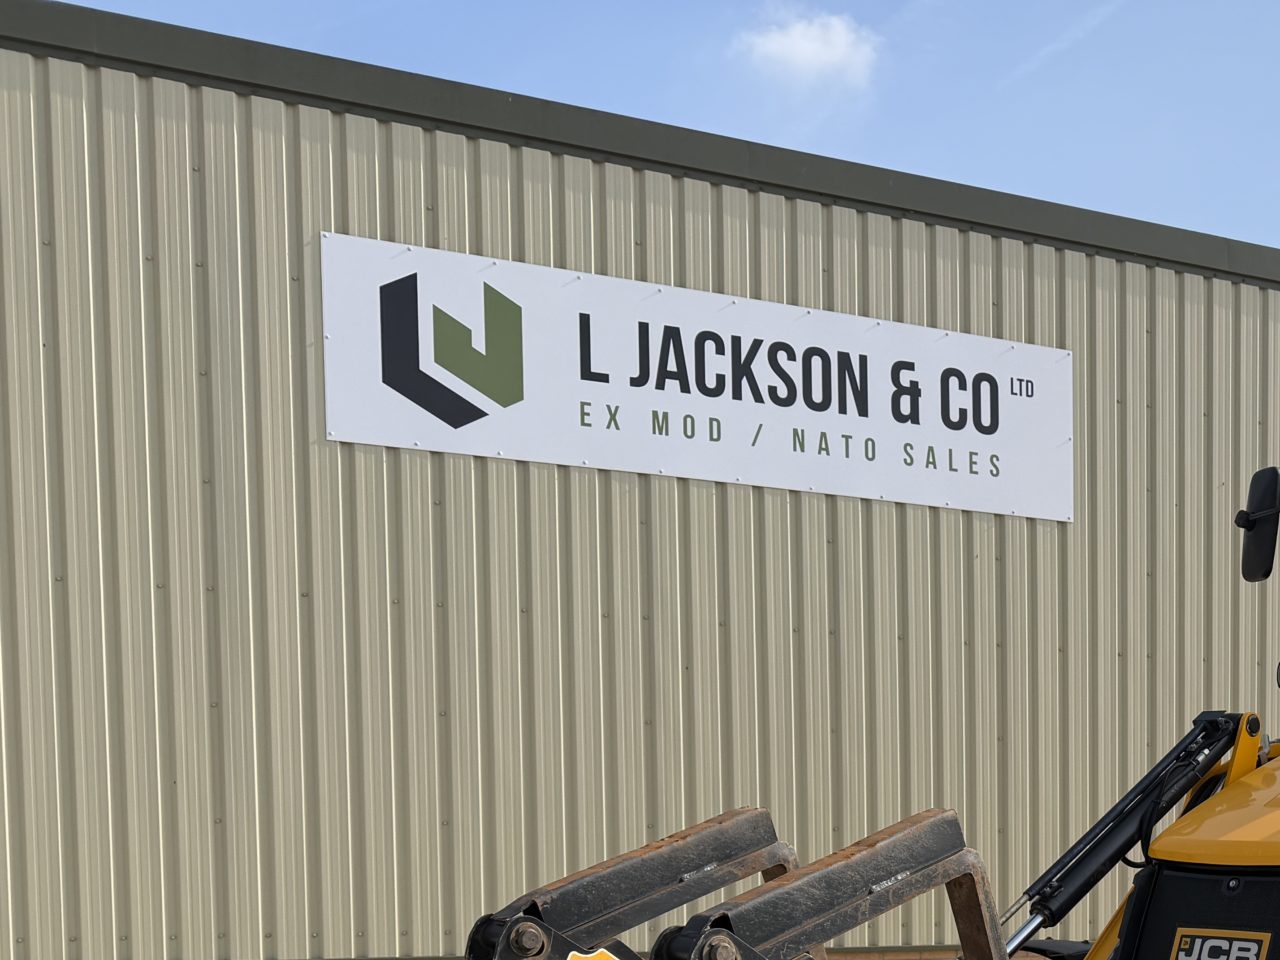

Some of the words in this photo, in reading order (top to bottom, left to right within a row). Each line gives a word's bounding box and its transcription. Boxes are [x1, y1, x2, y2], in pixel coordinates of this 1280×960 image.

[578, 312, 610, 384] L
[629, 320, 869, 419] JACKSON
[890, 360, 922, 426] &
[939, 367, 1000, 436] CO
[1010, 376, 1035, 398] LTD
[579, 401, 621, 431] EX
[651, 409, 722, 442] MOD
[751, 423, 764, 447] /
[792, 427, 877, 463] NATO
[903, 442, 1001, 478] SALES
